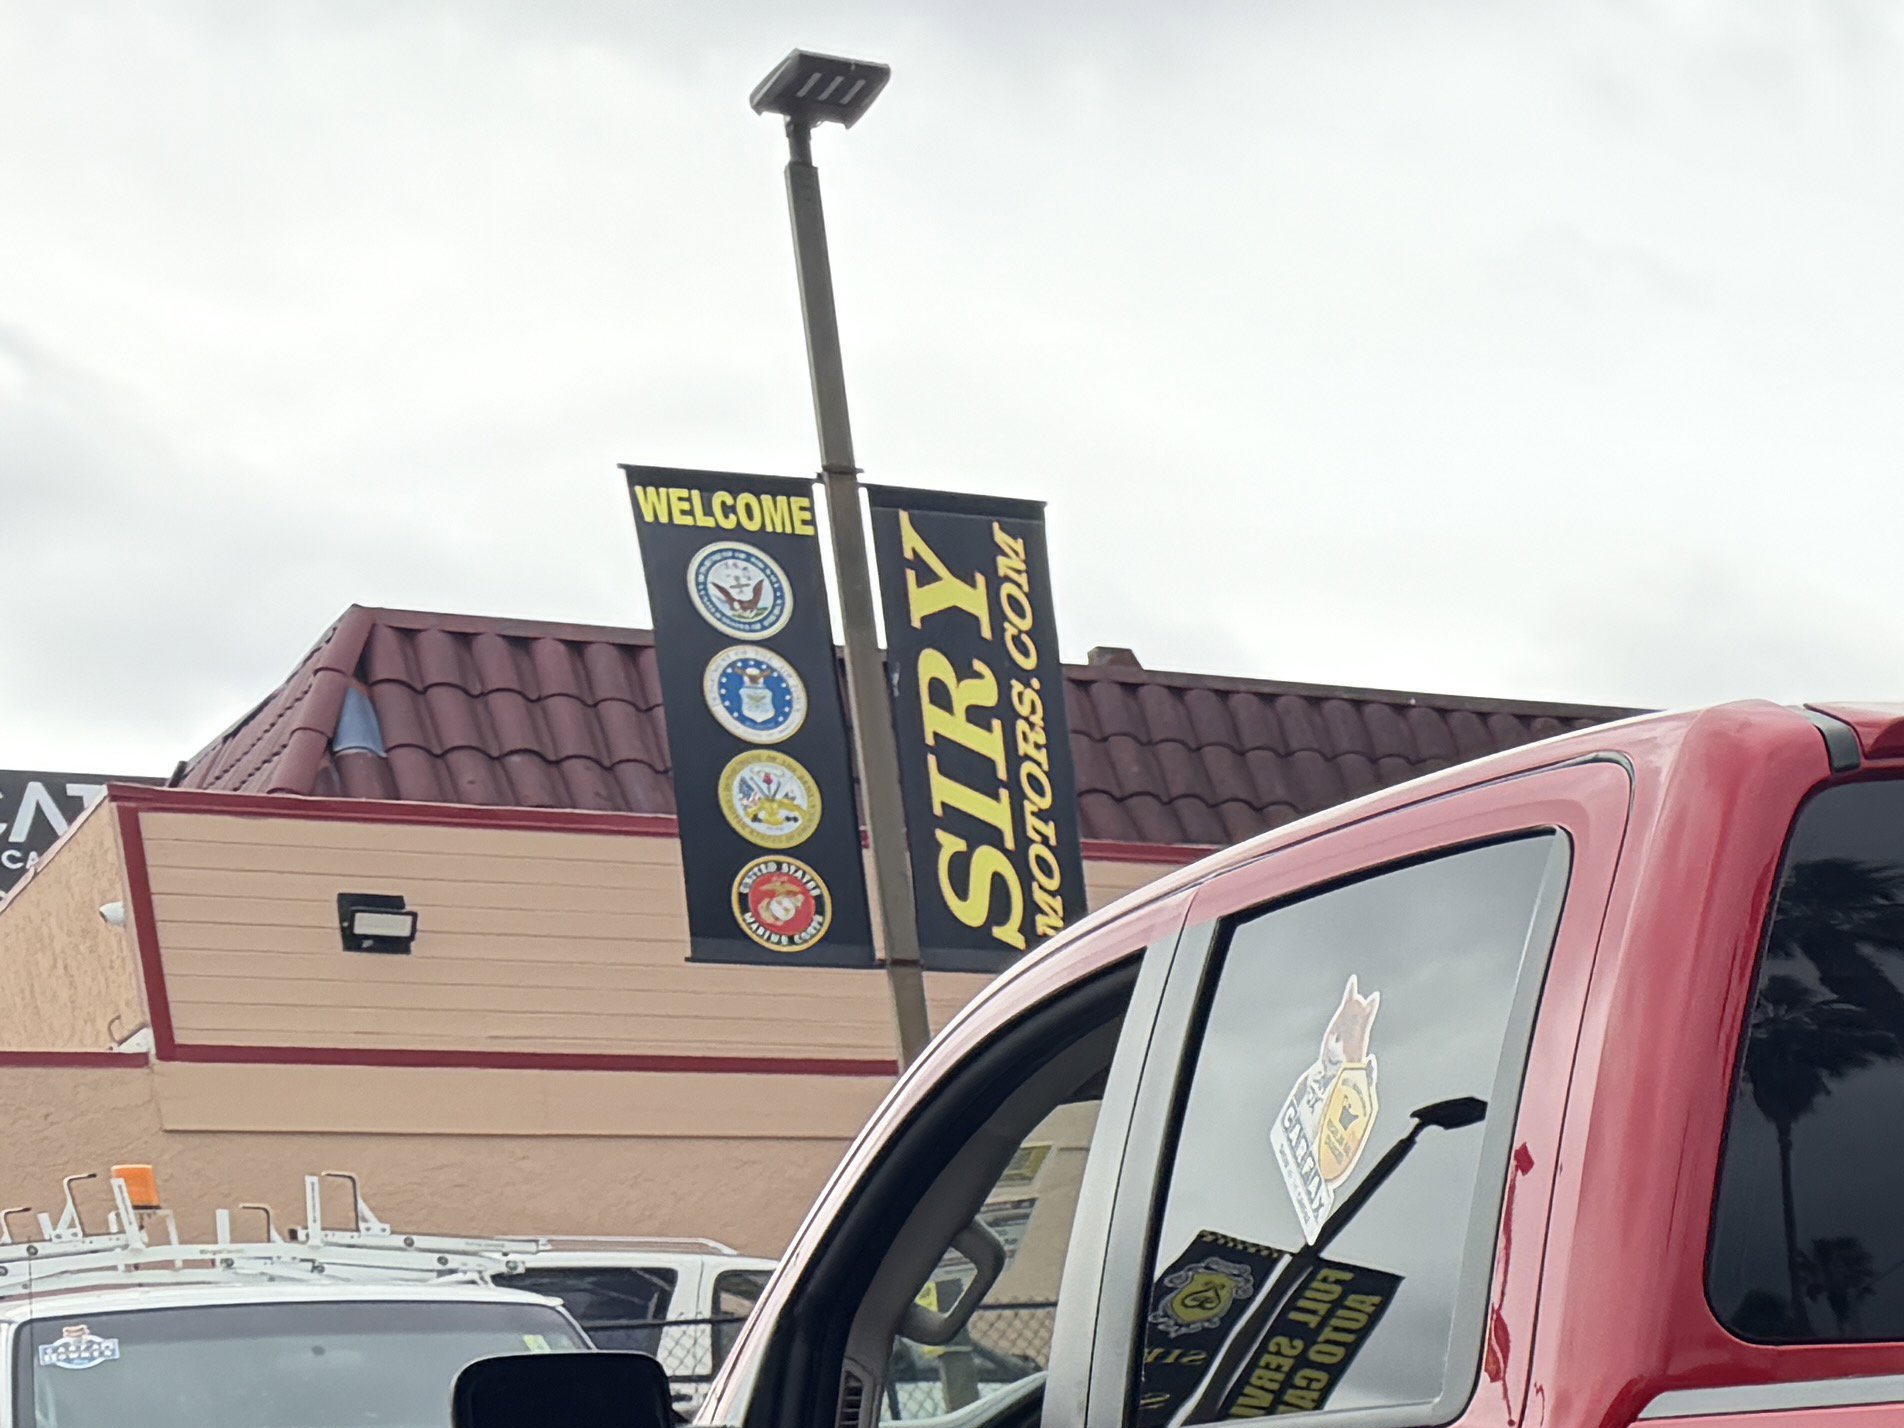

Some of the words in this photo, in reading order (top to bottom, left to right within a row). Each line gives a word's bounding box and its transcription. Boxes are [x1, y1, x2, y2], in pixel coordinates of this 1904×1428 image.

[634, 485, 815, 536] WELCOME
[899, 508, 1026, 951] SIRY
[992, 521, 1064, 937] MOTORS.COM
